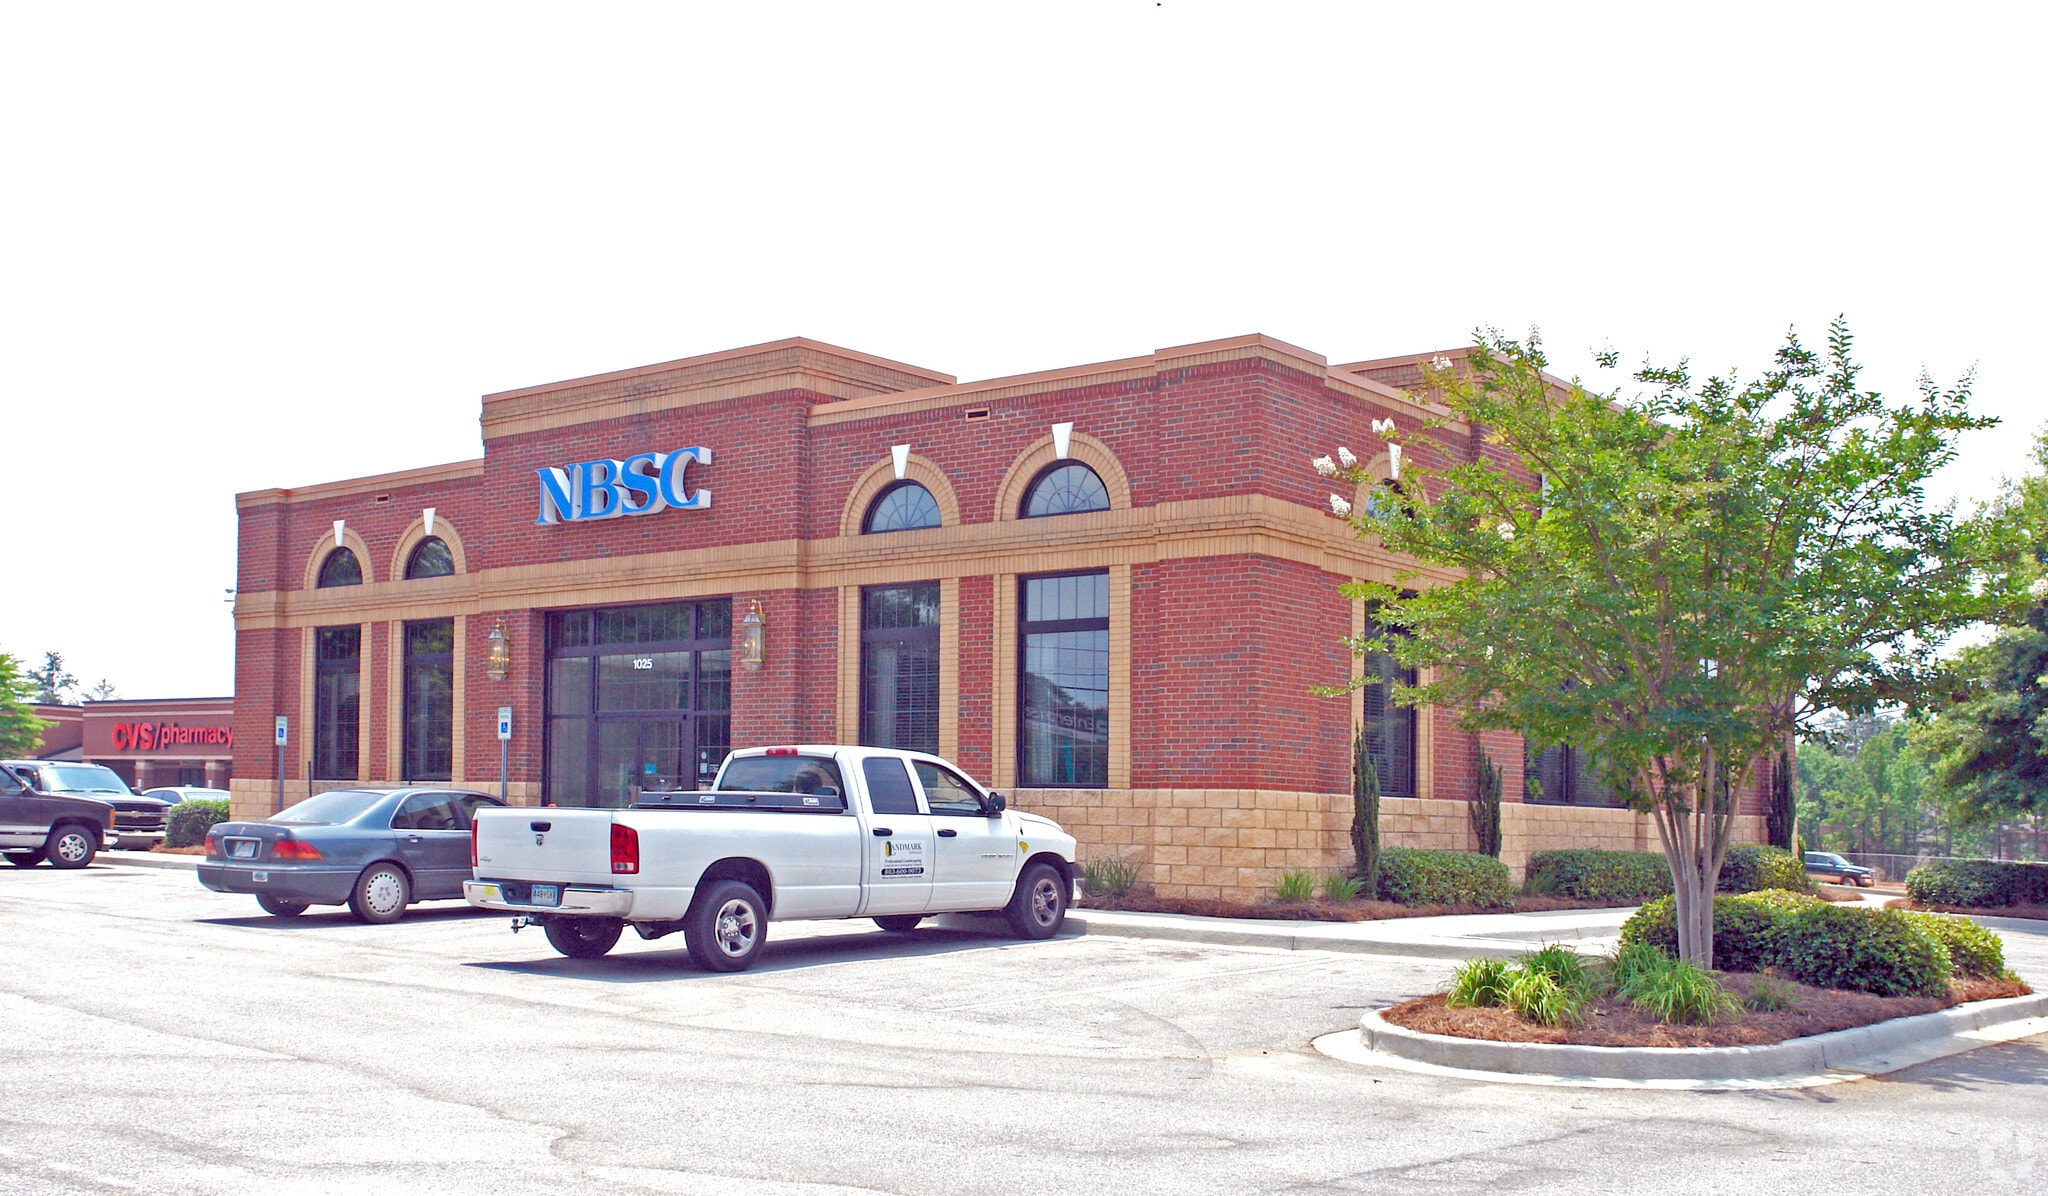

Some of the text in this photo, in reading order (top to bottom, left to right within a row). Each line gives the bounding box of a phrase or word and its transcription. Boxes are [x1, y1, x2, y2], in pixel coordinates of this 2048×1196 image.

[534, 446, 712, 524] NBSC
[633, 658, 653, 670] 1025
[112, 721, 234, 750] CVS/pharmacy
